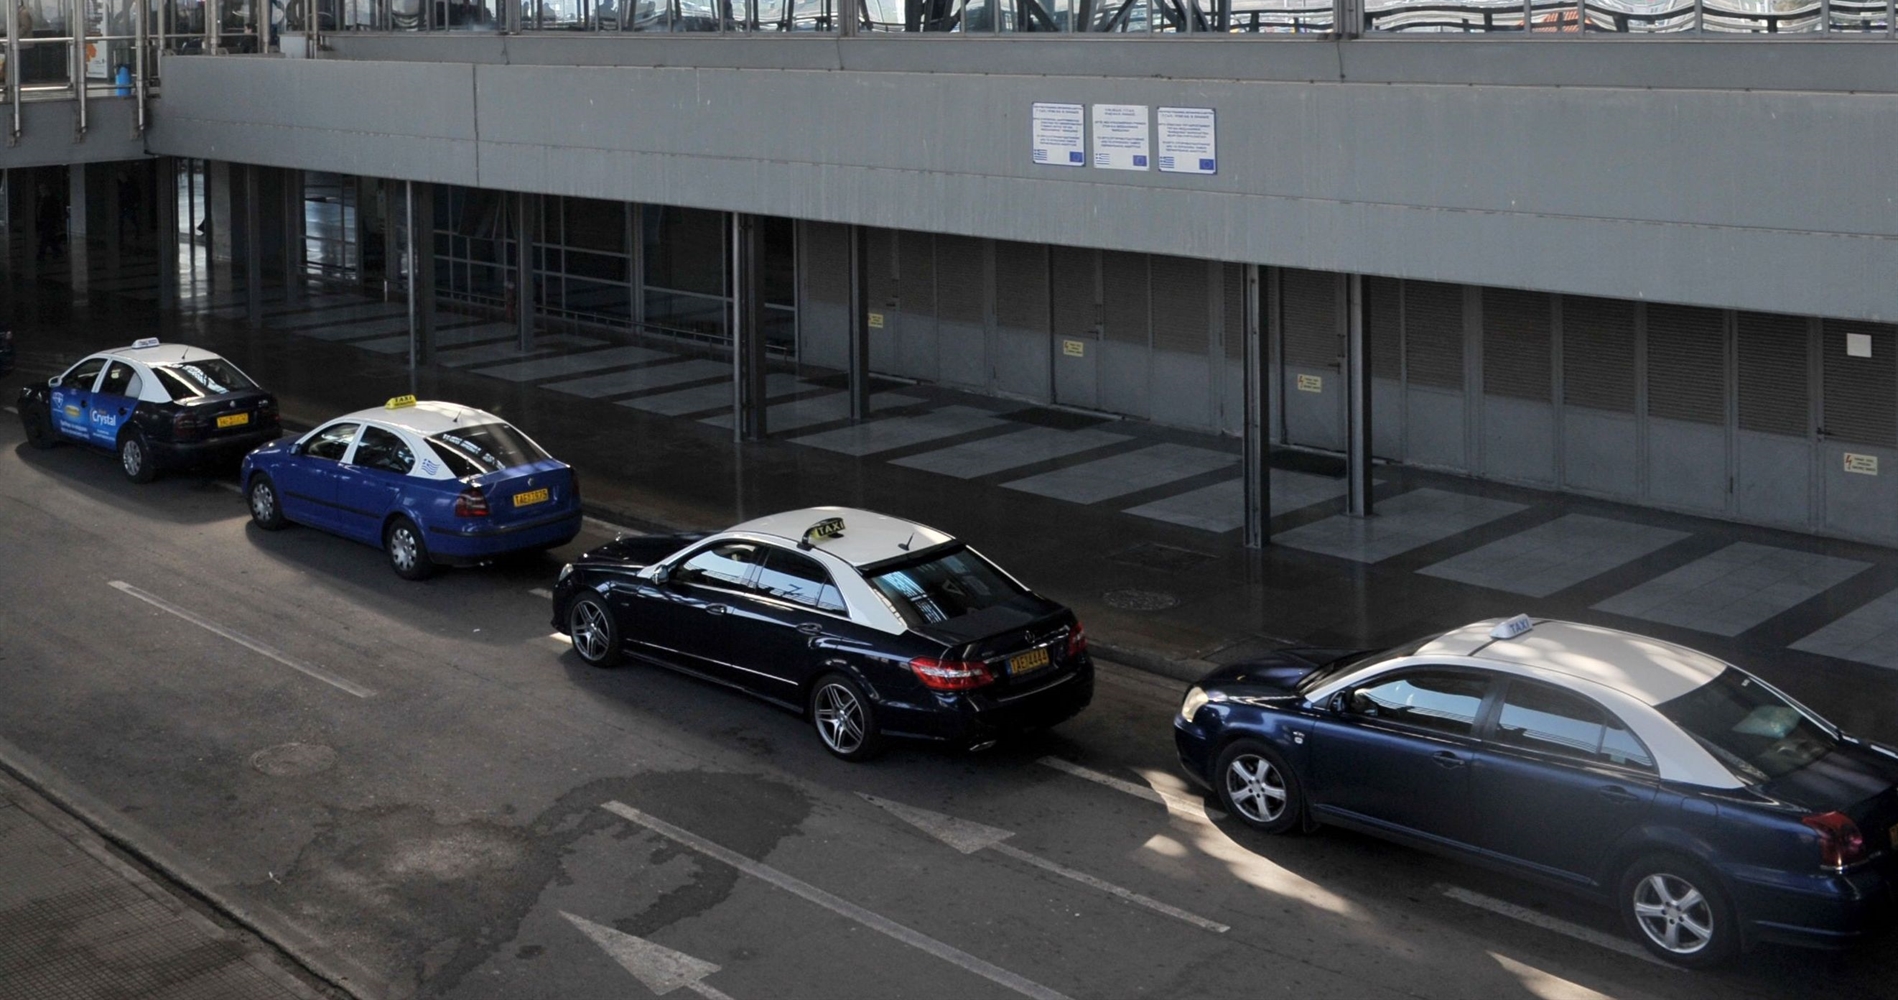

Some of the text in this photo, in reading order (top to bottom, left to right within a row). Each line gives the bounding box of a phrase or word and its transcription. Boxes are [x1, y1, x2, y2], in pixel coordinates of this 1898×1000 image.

[92, 409, 116, 426] Crystal
[818, 520, 844, 535] TAXI
[1509, 618, 1530, 634] TAXI
